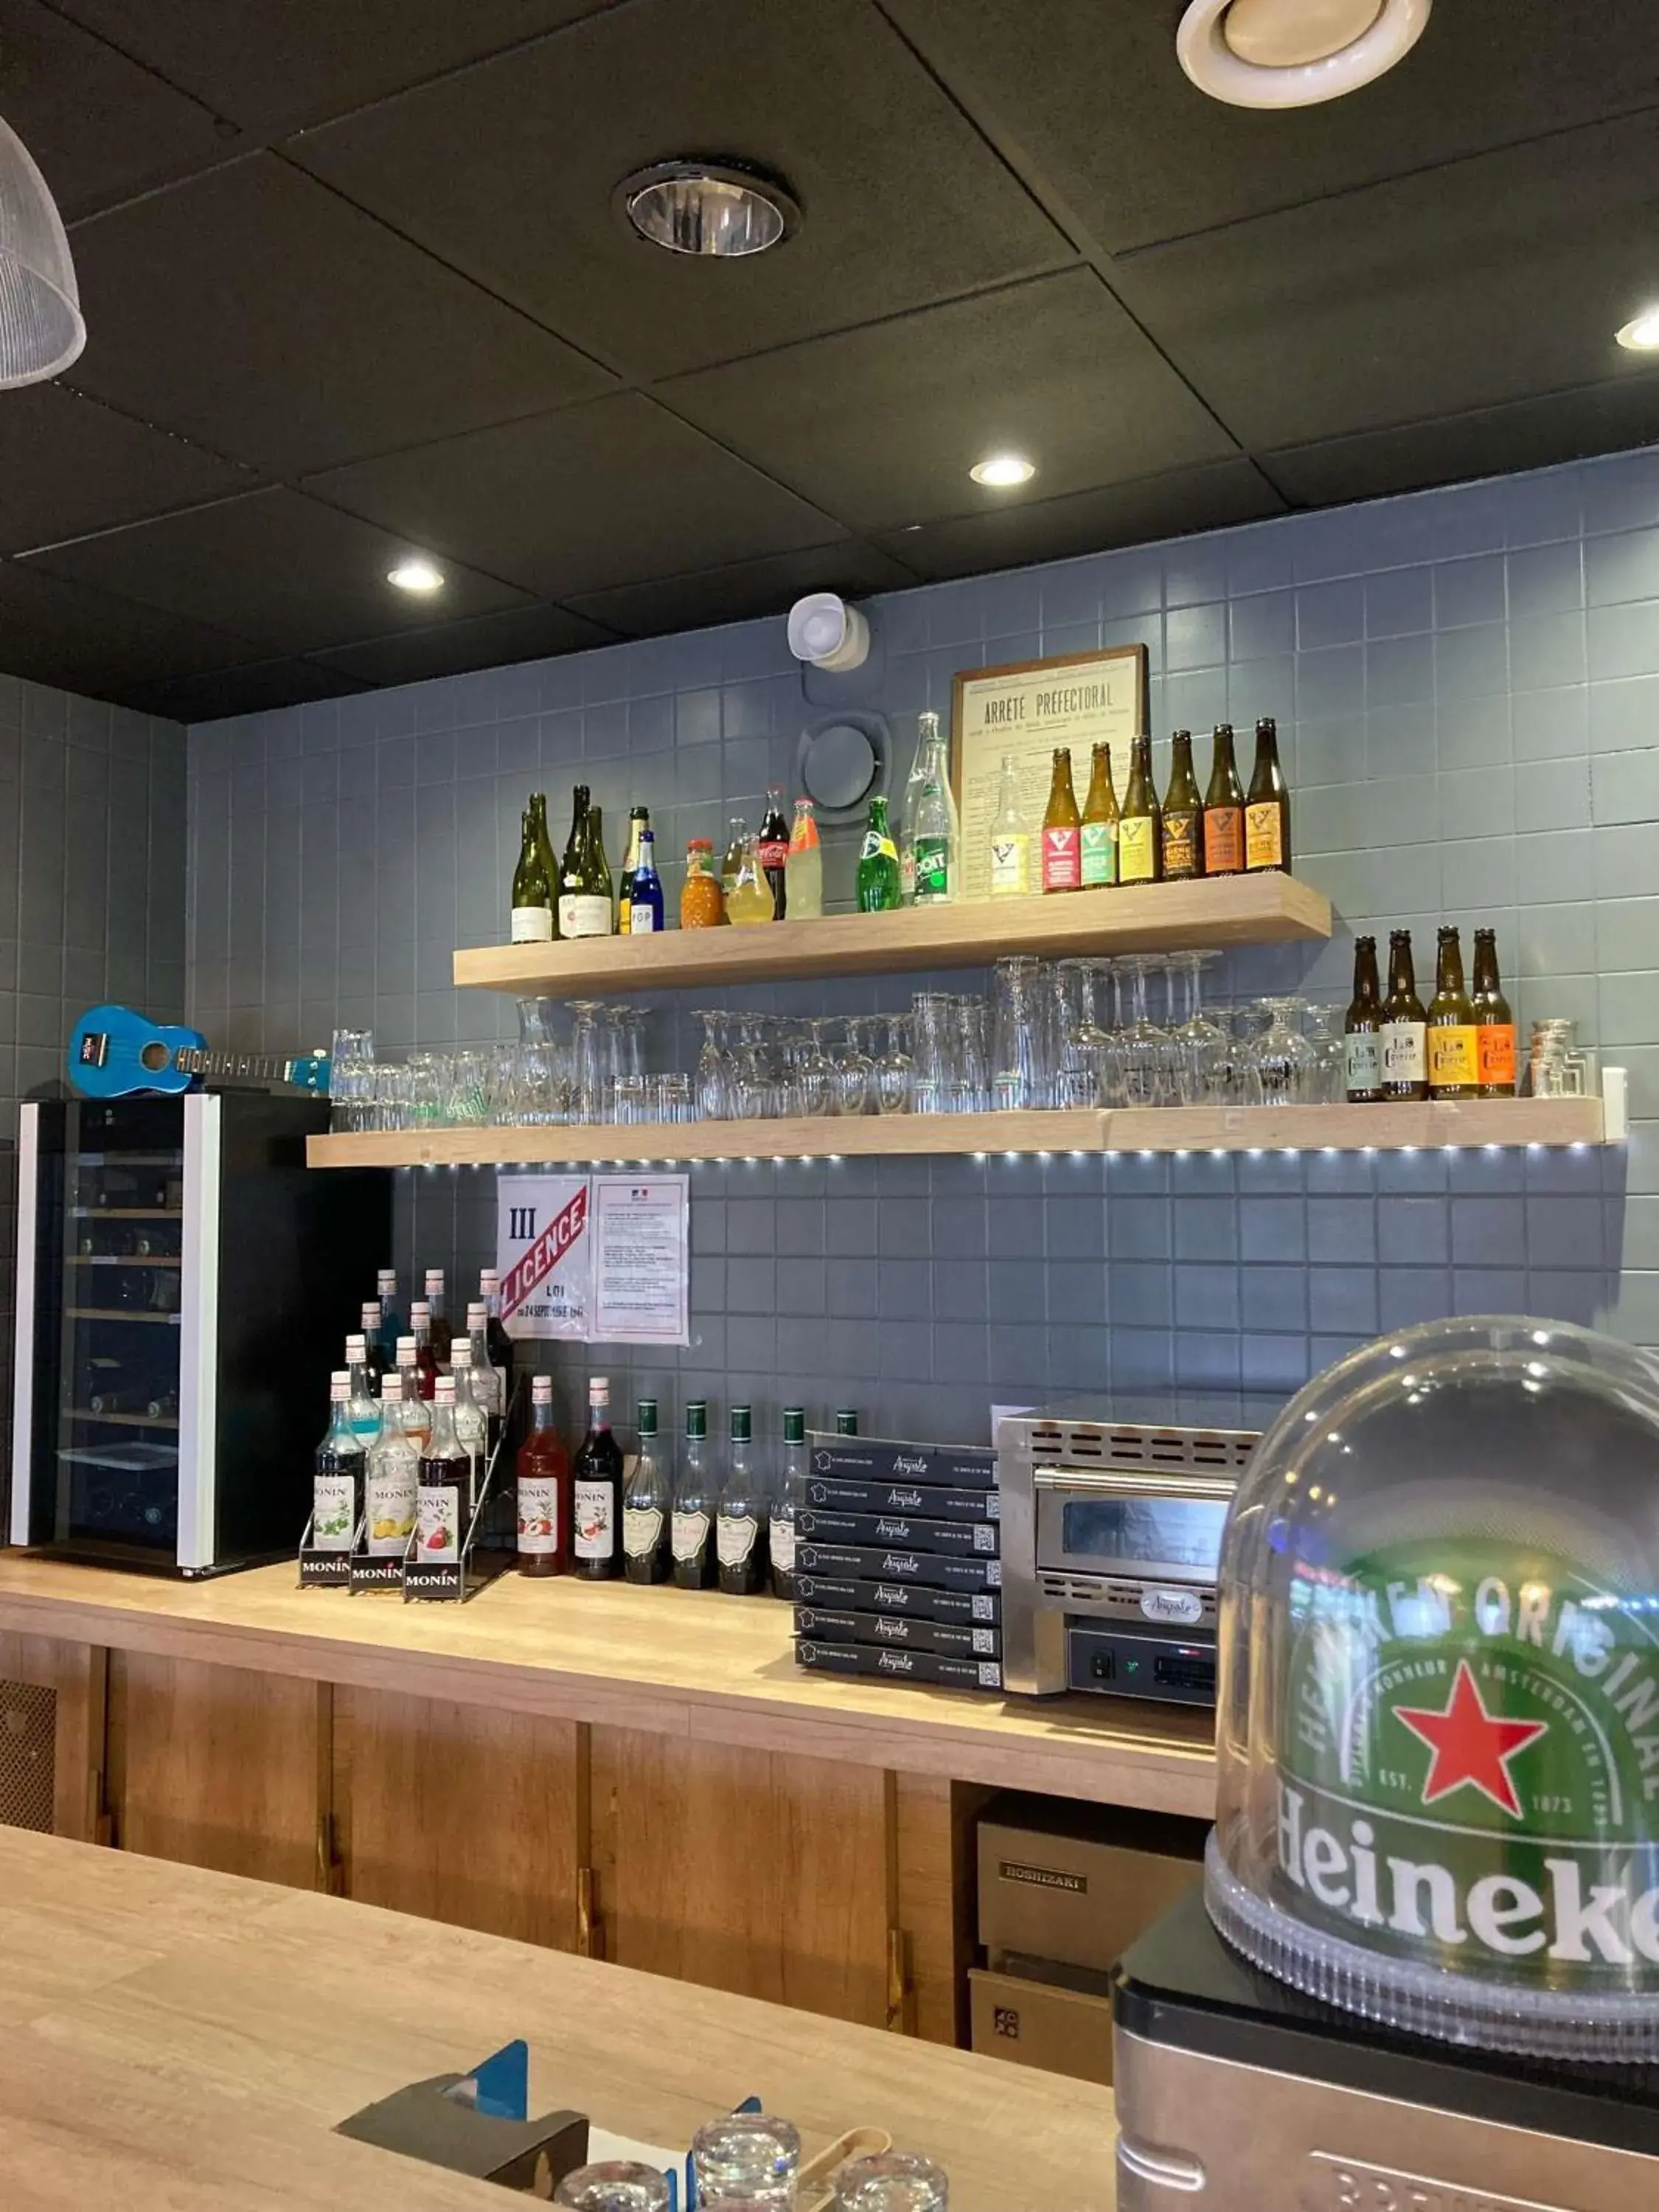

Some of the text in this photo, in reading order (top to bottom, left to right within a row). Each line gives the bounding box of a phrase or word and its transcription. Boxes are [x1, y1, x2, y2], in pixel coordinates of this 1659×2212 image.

[509, 1208, 536, 1239] III
[500, 1196, 582, 1315] LICENCE
[546, 1285, 565, 1297] LOI
[316, 1487, 346, 1497] ONIN
[303, 1558, 350, 1573] MONIN
[352, 1563, 403, 1579] MONIN
[406, 1571, 458, 1586] MONIN
[1378, 1769, 1411, 1791] EST.
[1532, 1795, 1572, 1815] 1873
[1006, 1866, 1079, 1889] HOSHIZAKI
